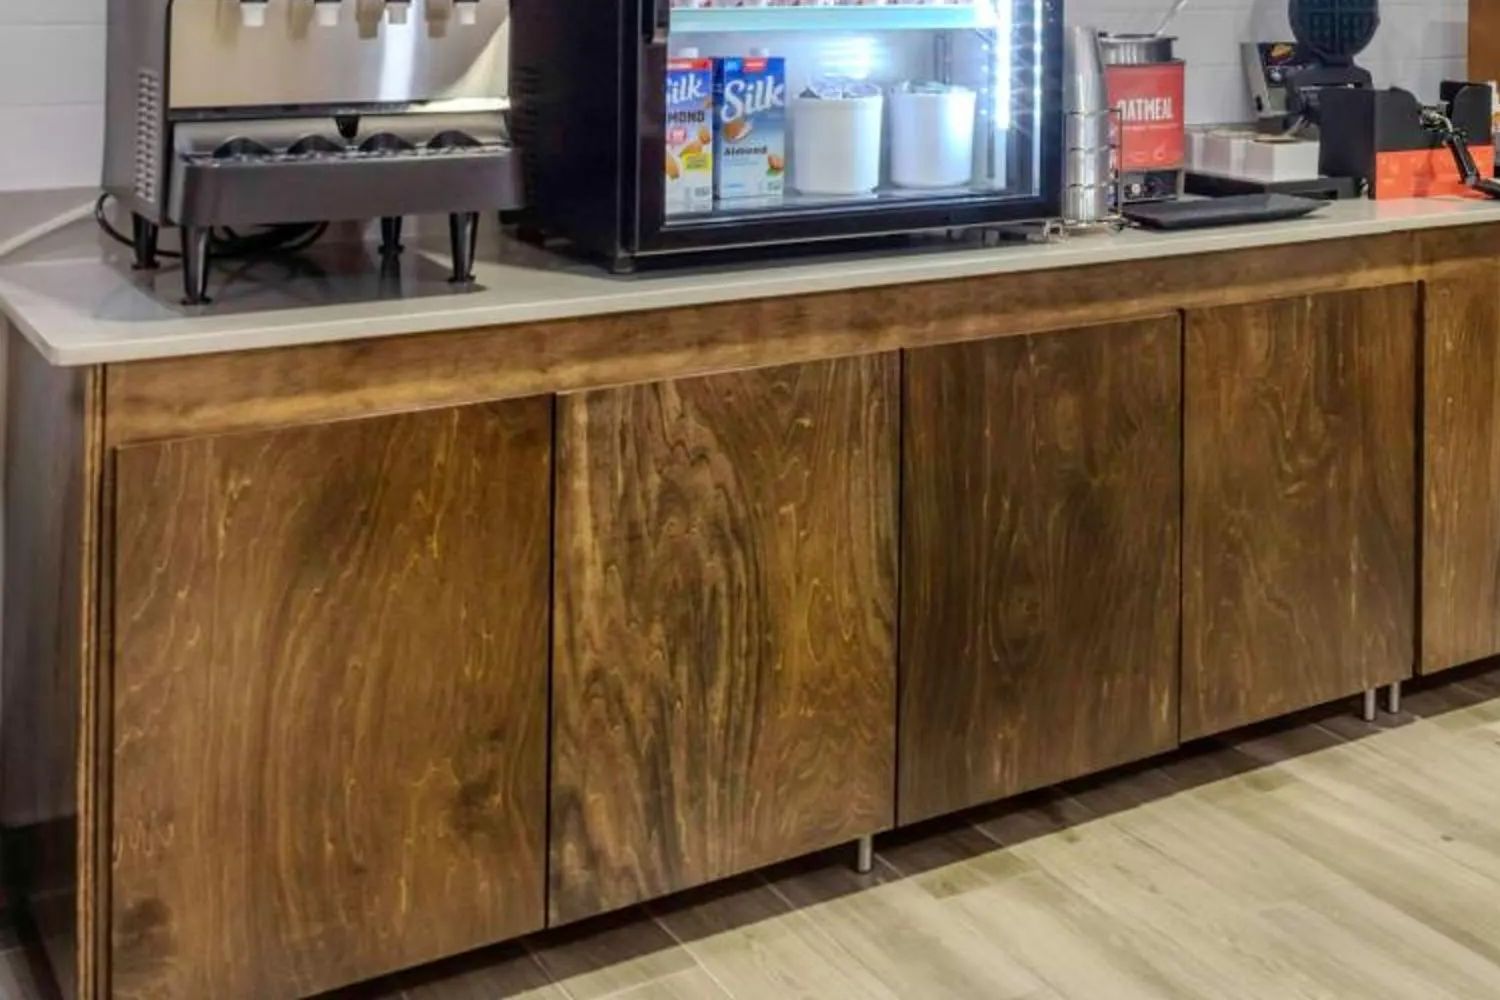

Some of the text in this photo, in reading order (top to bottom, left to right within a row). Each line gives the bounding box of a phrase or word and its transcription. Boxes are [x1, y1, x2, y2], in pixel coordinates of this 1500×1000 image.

[667, 73, 704, 105] ilk
[720, 75, 785, 122] Silk
[1117, 97, 1173, 121] OATMEAL
